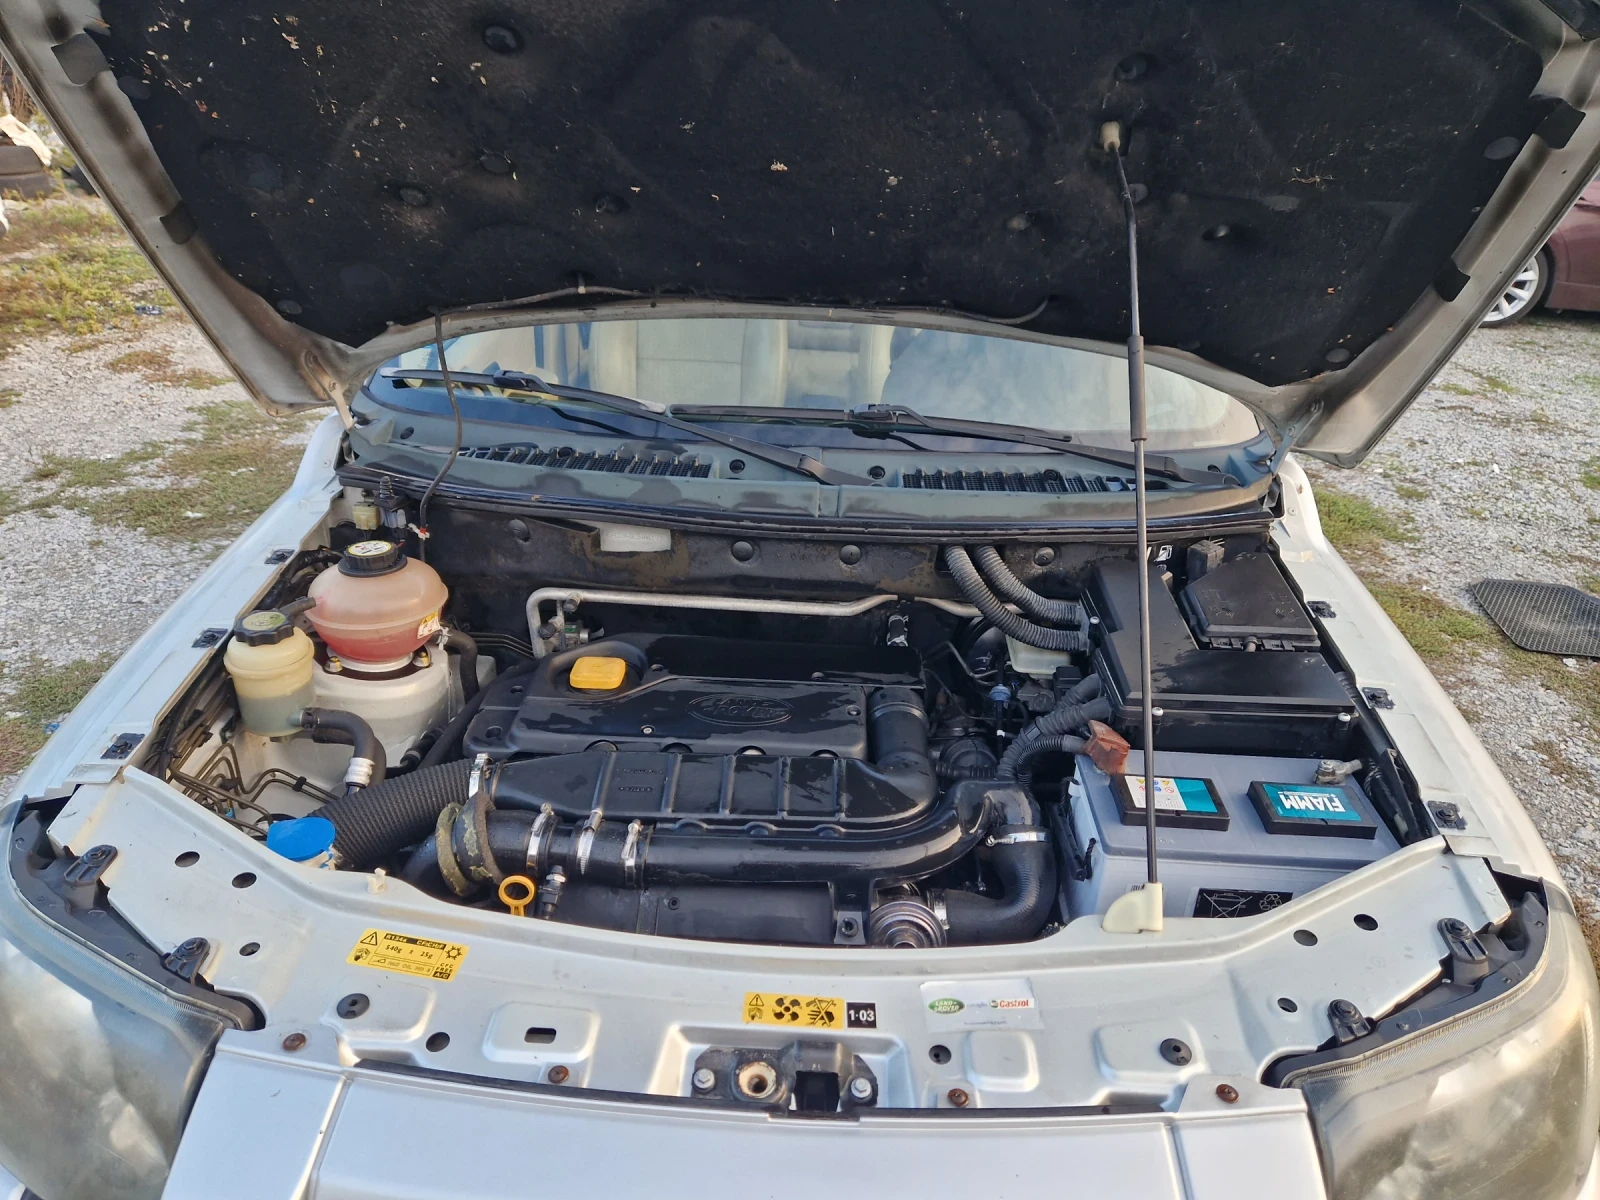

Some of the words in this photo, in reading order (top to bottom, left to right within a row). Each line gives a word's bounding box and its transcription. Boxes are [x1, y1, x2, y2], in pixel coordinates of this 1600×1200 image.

[1279, 794, 1346, 812] FIAMM
[385, 944, 402, 954] 540g
[420, 951, 434, 960] 25g
[999, 999, 1029, 1008] Castrol
